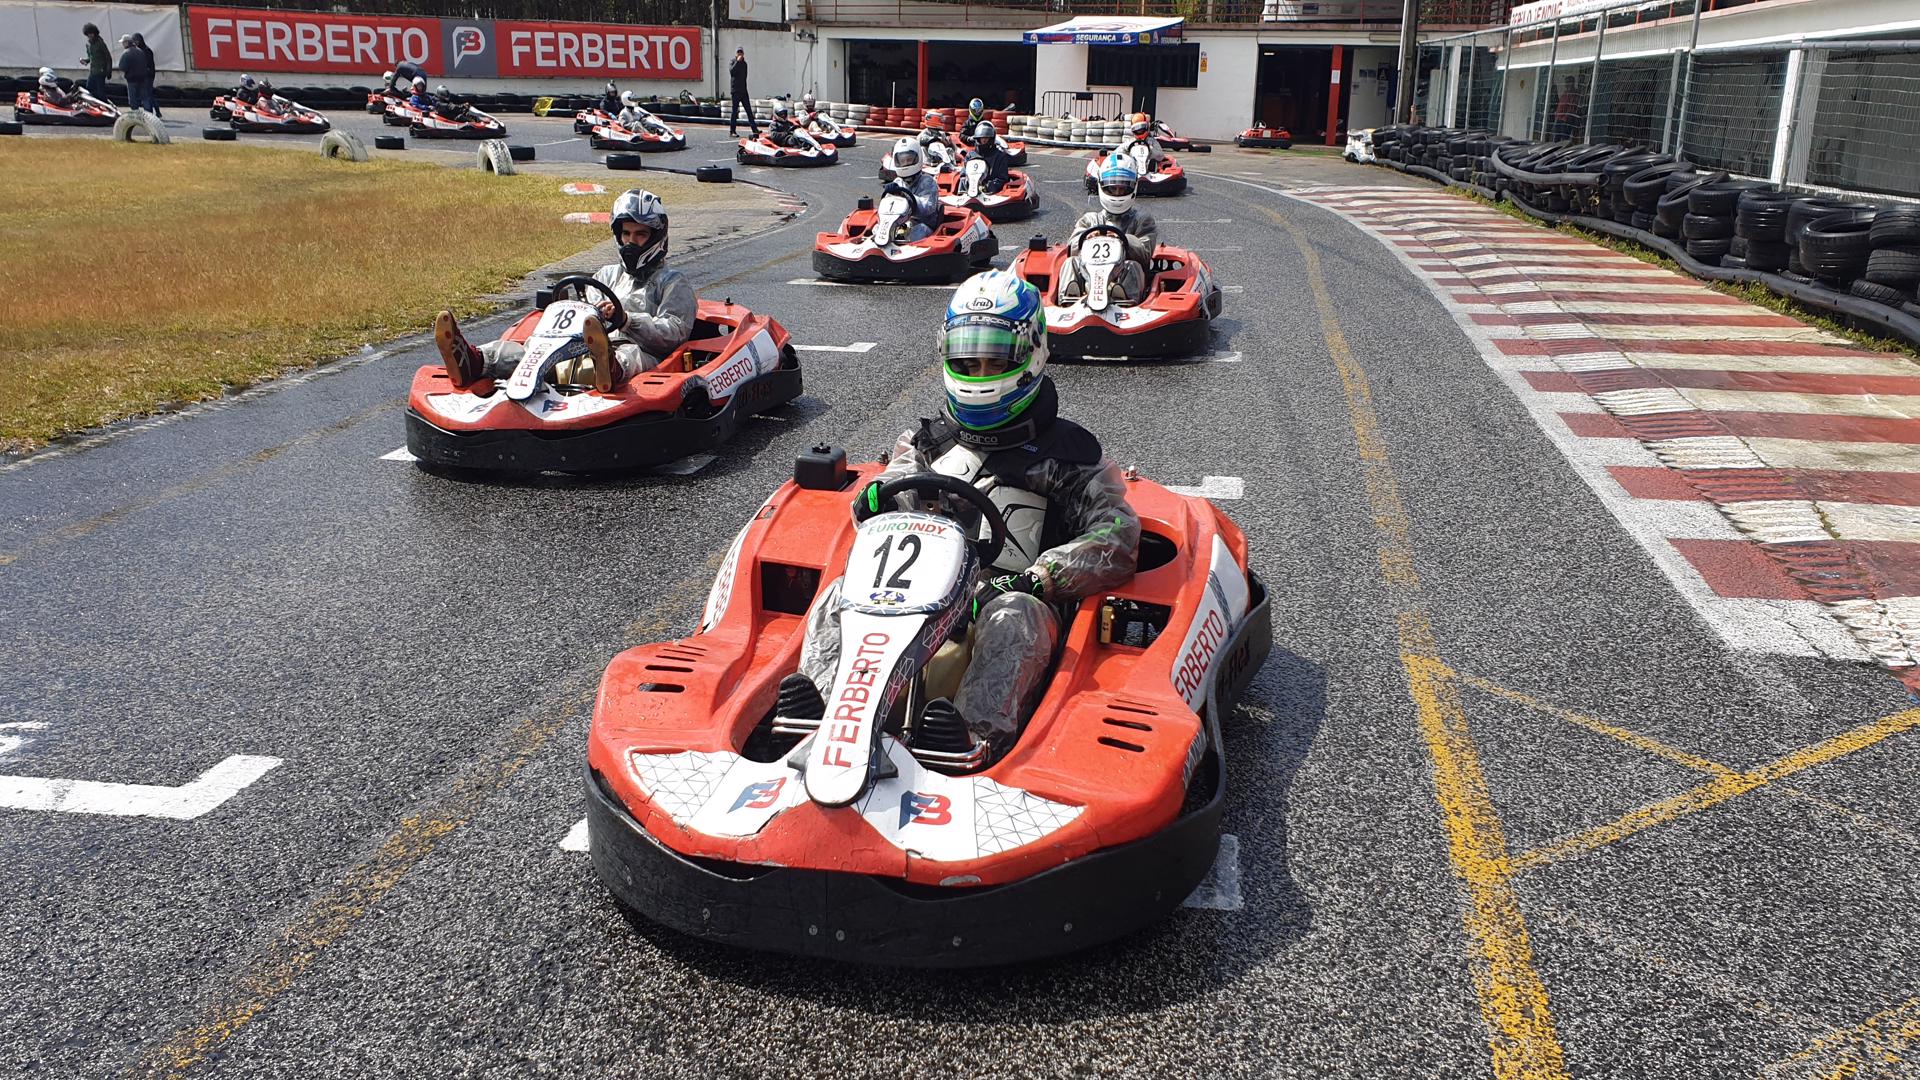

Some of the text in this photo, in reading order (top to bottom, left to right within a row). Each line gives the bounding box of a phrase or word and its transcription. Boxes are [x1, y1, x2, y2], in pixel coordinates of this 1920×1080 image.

[207, 18, 429, 66] FERBERTO
[1075, 34, 1117, 43] SEGURANÇA
[511, 31, 691, 71] FERBERTO
[973, 163, 979, 172] 9
[1092, 243, 1111, 259] 23
[552, 309, 577, 330] 18
[960, 430, 998, 443] sparco
[867, 522, 948, 536] EUROINDY
[872, 533, 922, 590] 12
[1174, 609, 1224, 706] ERBERTO
[822, 632, 891, 769] FERBERTO
